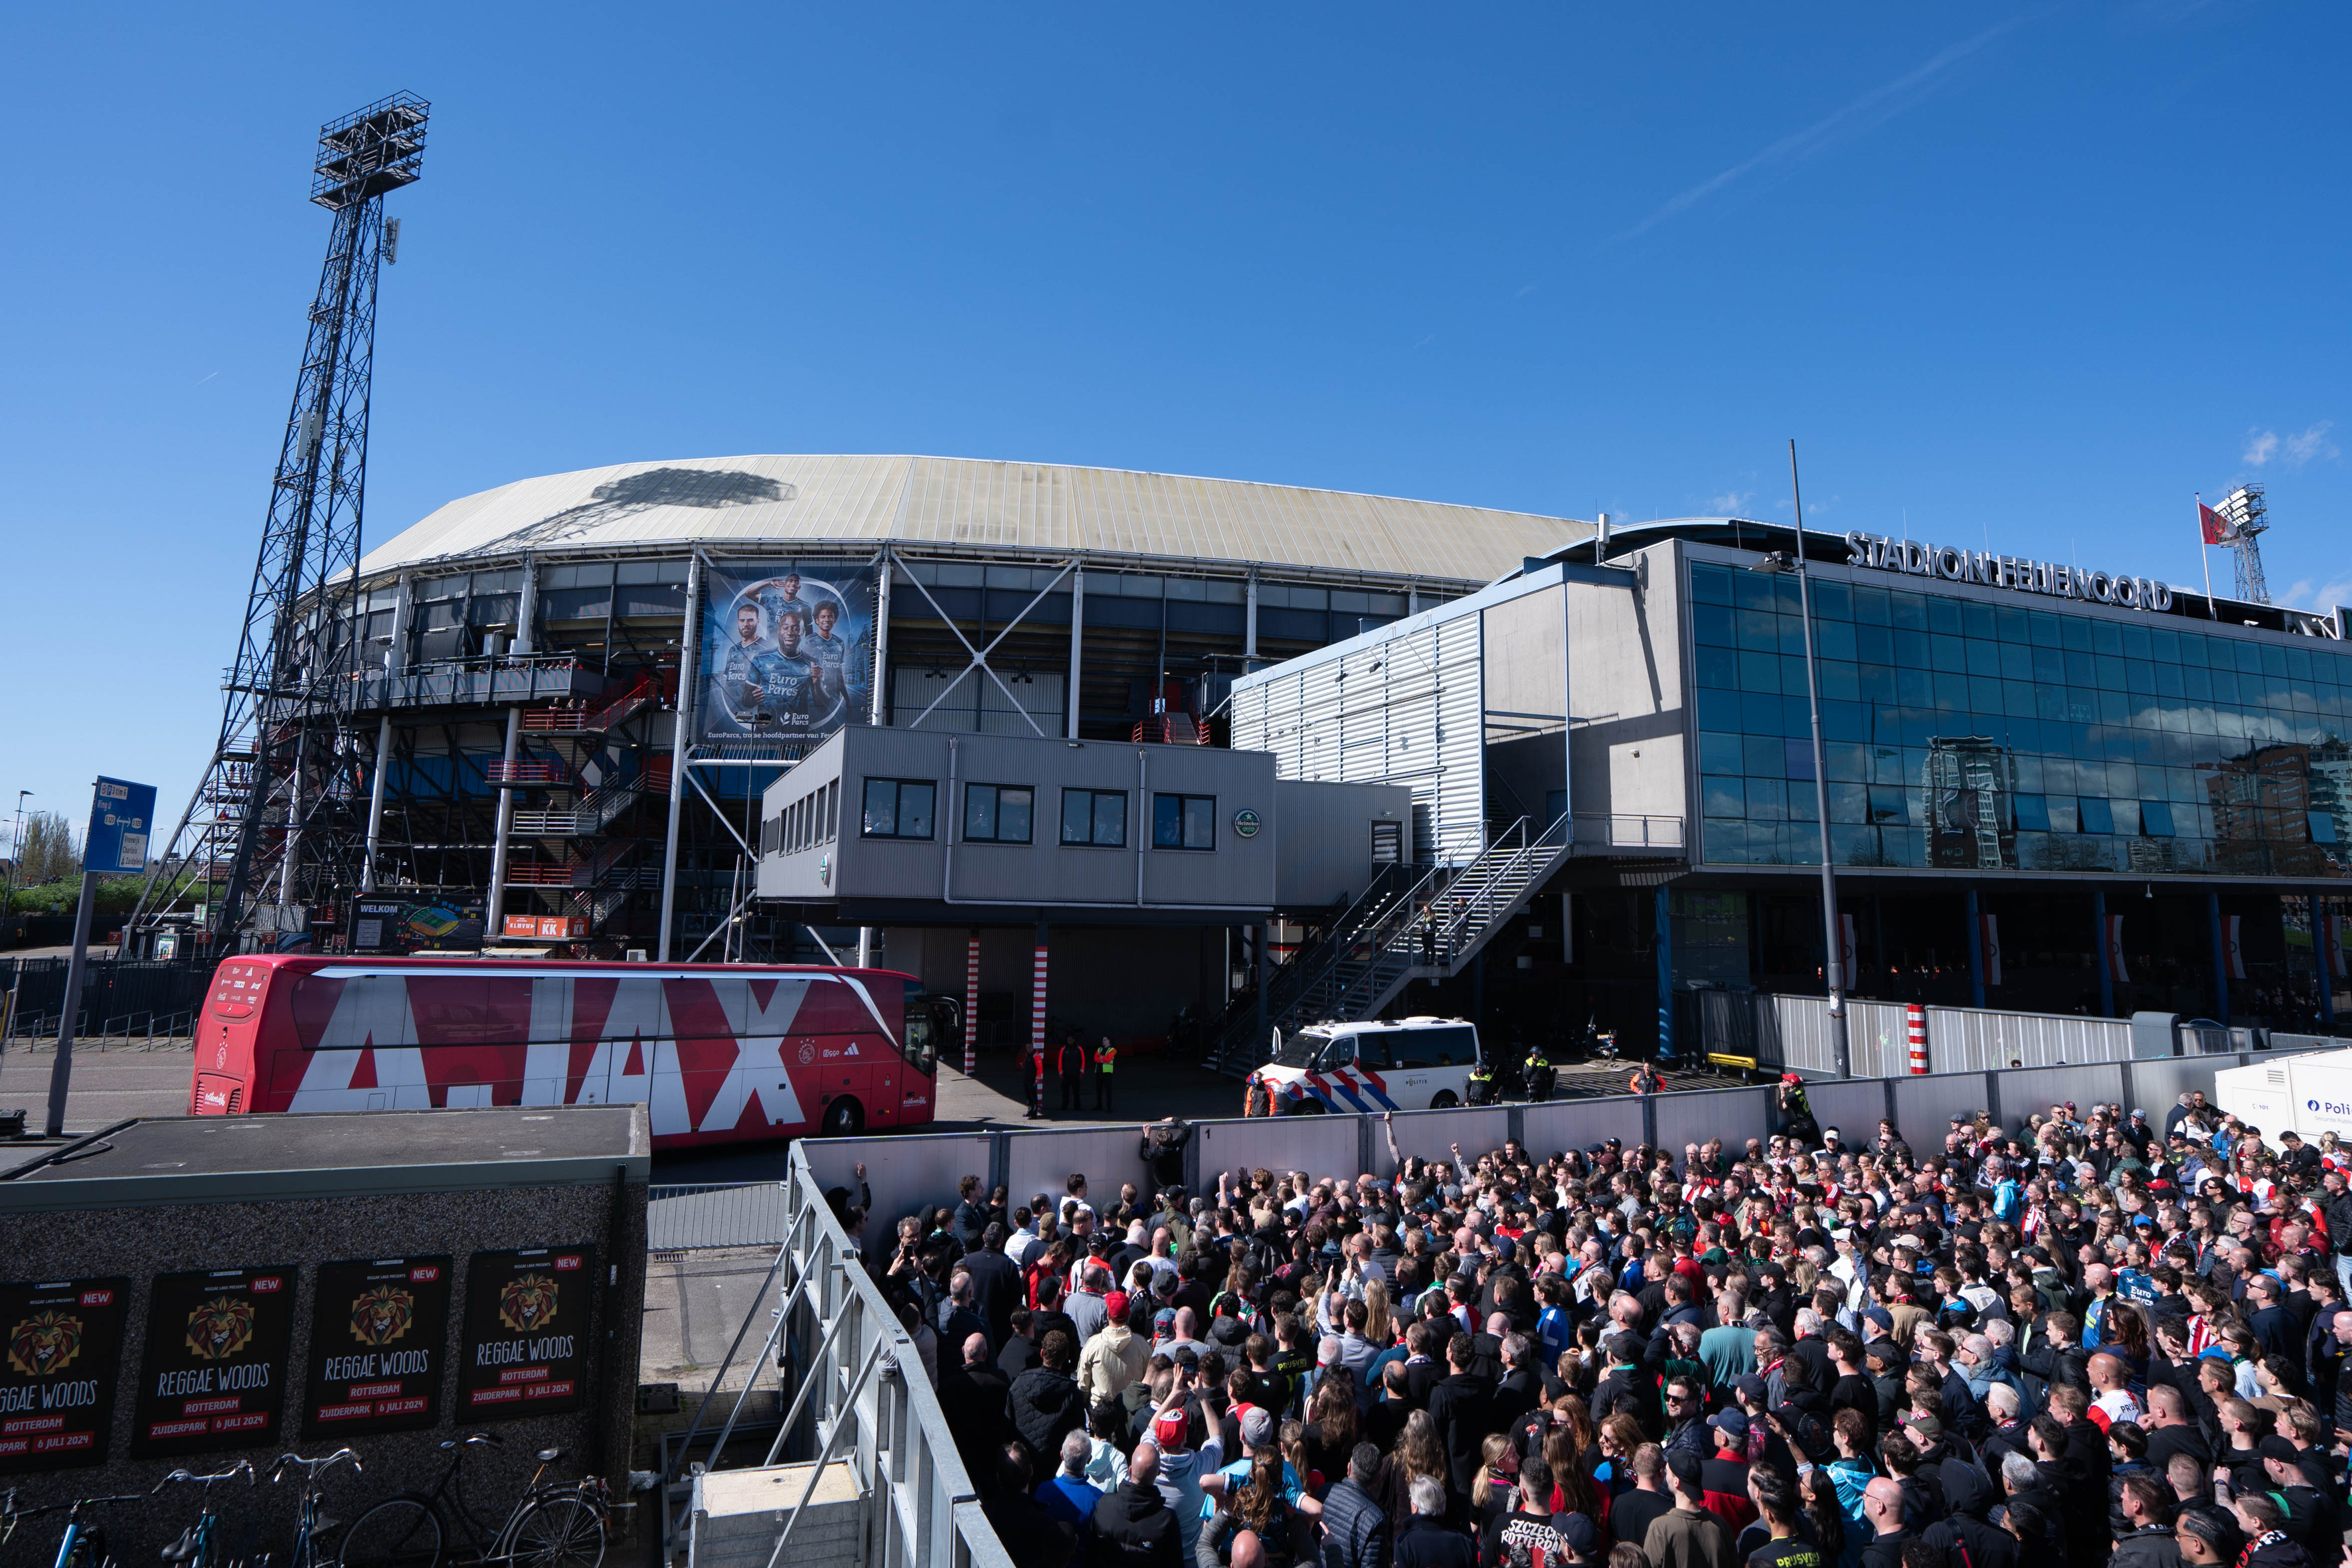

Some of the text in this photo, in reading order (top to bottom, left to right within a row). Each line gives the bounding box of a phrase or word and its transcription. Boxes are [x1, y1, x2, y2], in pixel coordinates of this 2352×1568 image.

[1845, 530, 2173, 611] STADION FEIJENOORD
[823, 651, 838, 660] Euro
[729, 662, 744, 670] Euro
[822, 660, 839, 668] Parcs
[769, 672, 797, 686] Euro
[768, 684, 798, 696] Parcs
[360, 904, 398, 913] WELKOM
[542, 923, 557, 935] KK
[573, 924, 585, 935] KK
[287, 976, 812, 1137] AJAX
[823, 1049, 840, 1058] Ziggo
[2325, 1102, 2352, 1115] Poli
[1205, 1128, 1211, 1139] 1
[558, 1257, 579, 1268] NEW
[413, 1269, 436, 1279] NEW
[254, 1279, 279, 1291] NEW
[83, 1292, 110, 1304] NEW
[2130, 1285, 2151, 1299] Euro
[477, 1335, 574, 1366] REGGAE WOODS
[325, 1349, 429, 1381] REGGAE WOODS
[157, 1363, 270, 1397] REGGAE WOODS
[501, 1368, 547, 1381] ROTTERDAM
[42, 1379, 98, 1409] WOODS
[350, 1384, 400, 1397] ROTTERDAM
[473, 1388, 520, 1402] ZUIDERPARK
[535, 1385, 550, 1397] JULI
[552, 1383, 570, 1393] 2024
[185, 1399, 238, 1413] ROTTERDAM
[319, 1405, 371, 1418] ZUIDERPARK
[379, 1399, 424, 1413] 6 JULI 2024
[5, 1418, 63, 1433] ROTTERDAM
[151, 1421, 207, 1435] ZUIDERPARK
[216, 1415, 263, 1431] 6 JULI 2024
[37, 1435, 89, 1450] 6 JULI 2024
